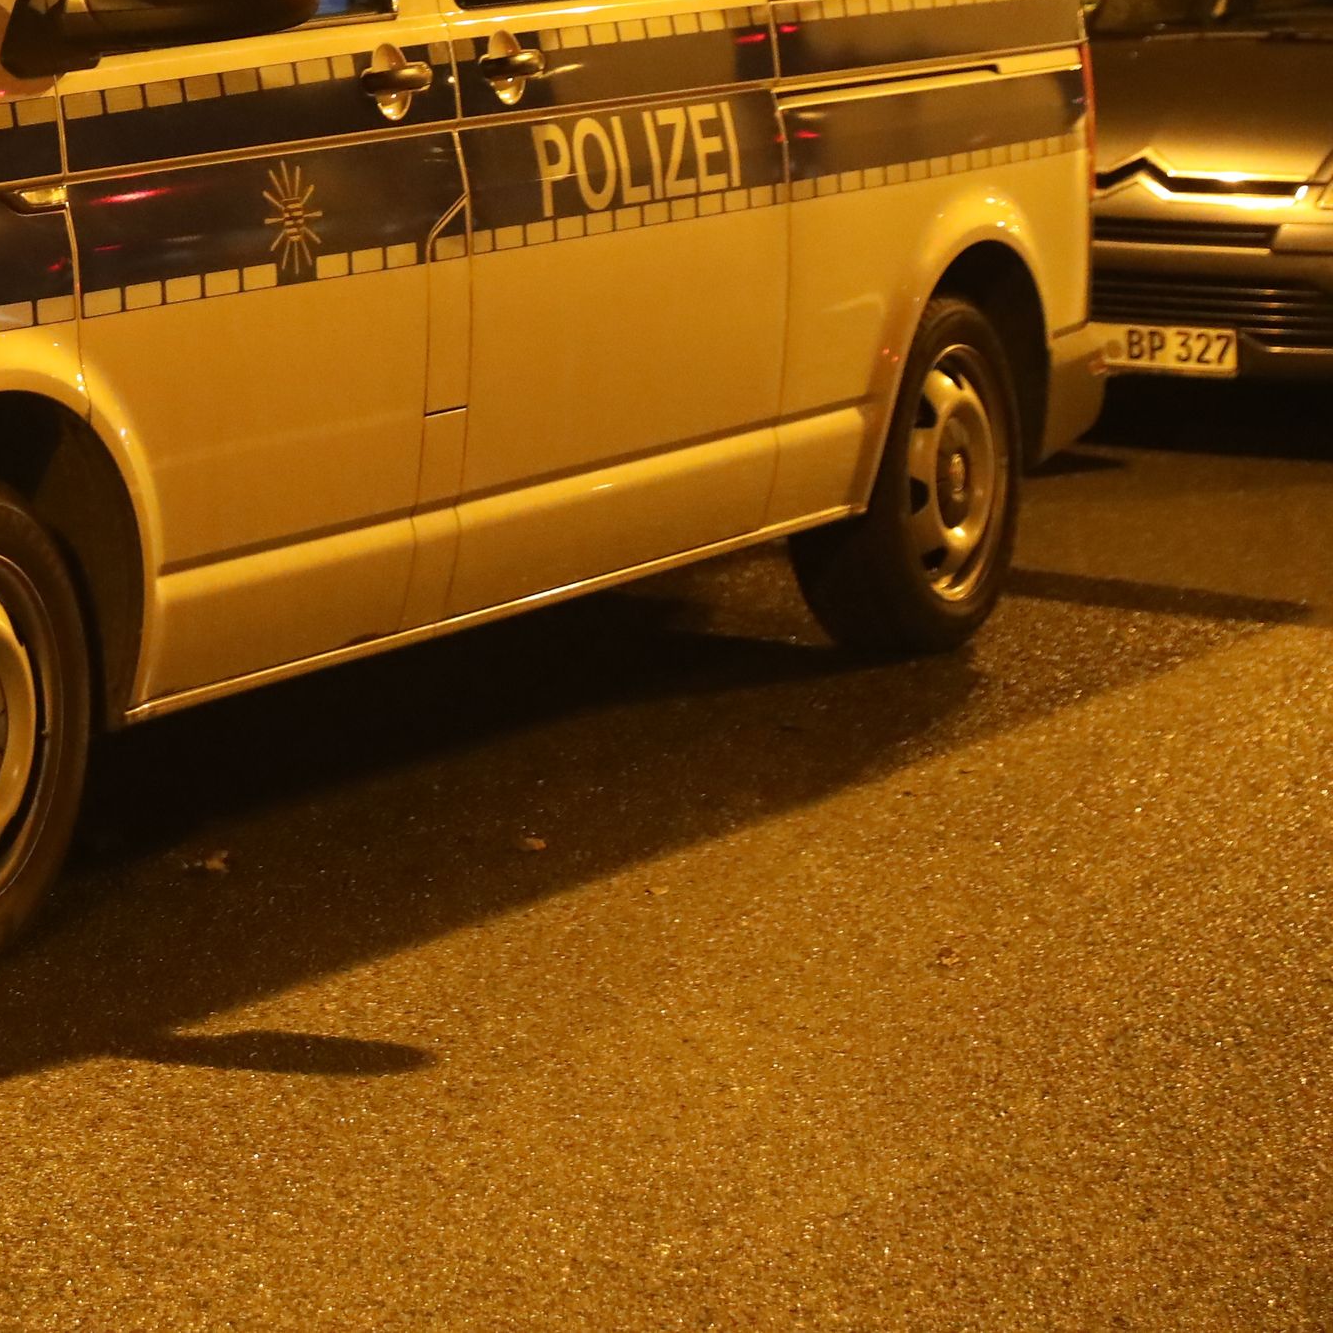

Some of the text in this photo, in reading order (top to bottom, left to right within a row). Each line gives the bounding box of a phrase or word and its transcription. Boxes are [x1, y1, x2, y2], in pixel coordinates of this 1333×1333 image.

[530, 100, 742, 218] POLIZEI
[1126, 329, 1231, 364] BP 327
